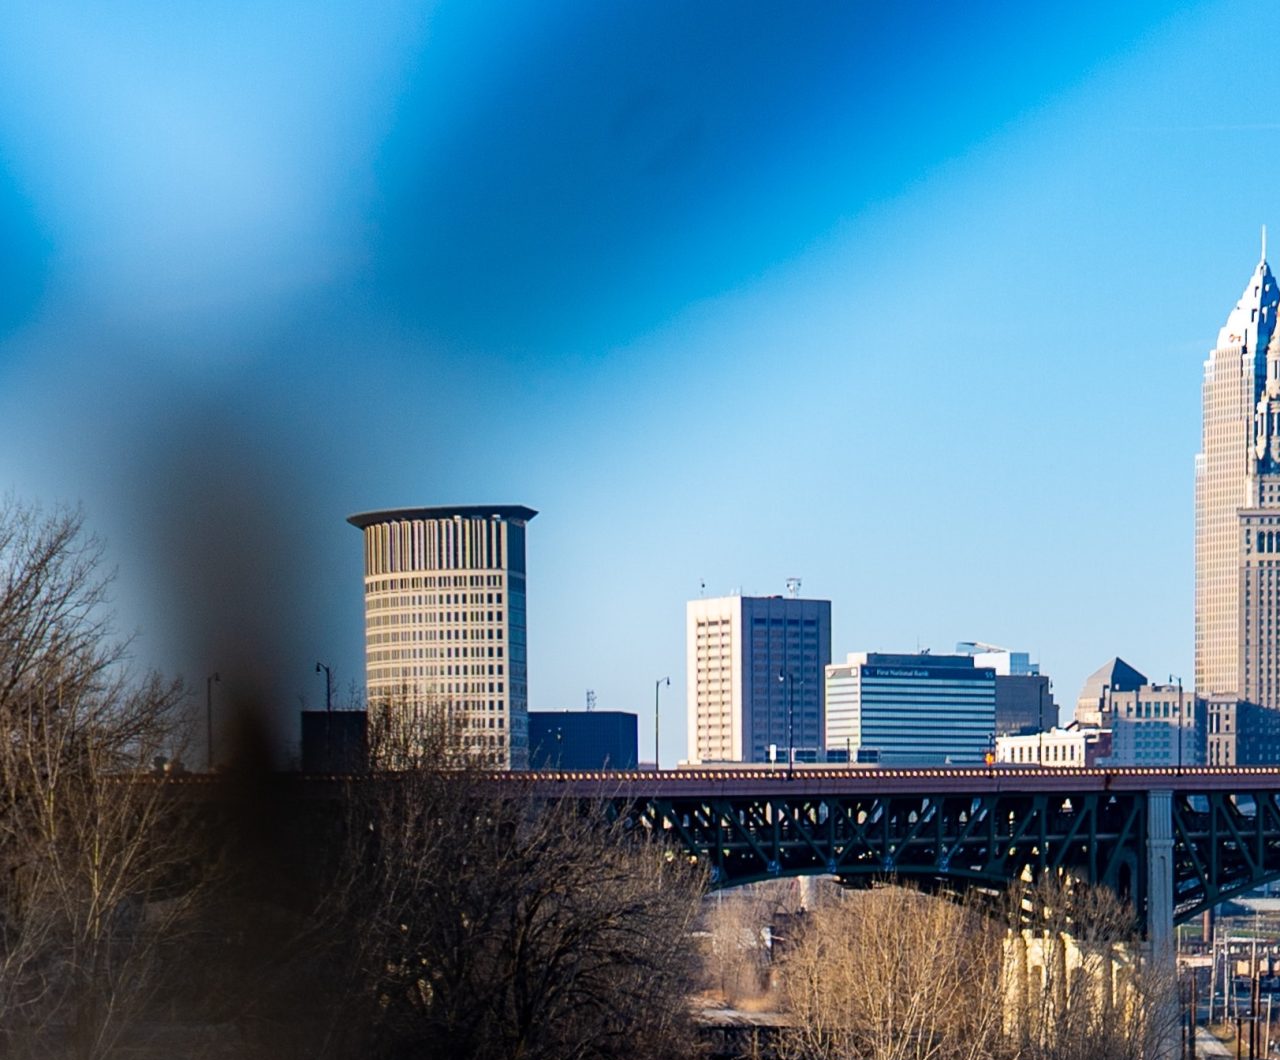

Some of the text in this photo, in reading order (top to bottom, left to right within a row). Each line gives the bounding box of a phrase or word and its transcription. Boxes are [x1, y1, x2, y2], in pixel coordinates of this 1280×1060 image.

[877, 668, 929, 677] First National Bank
